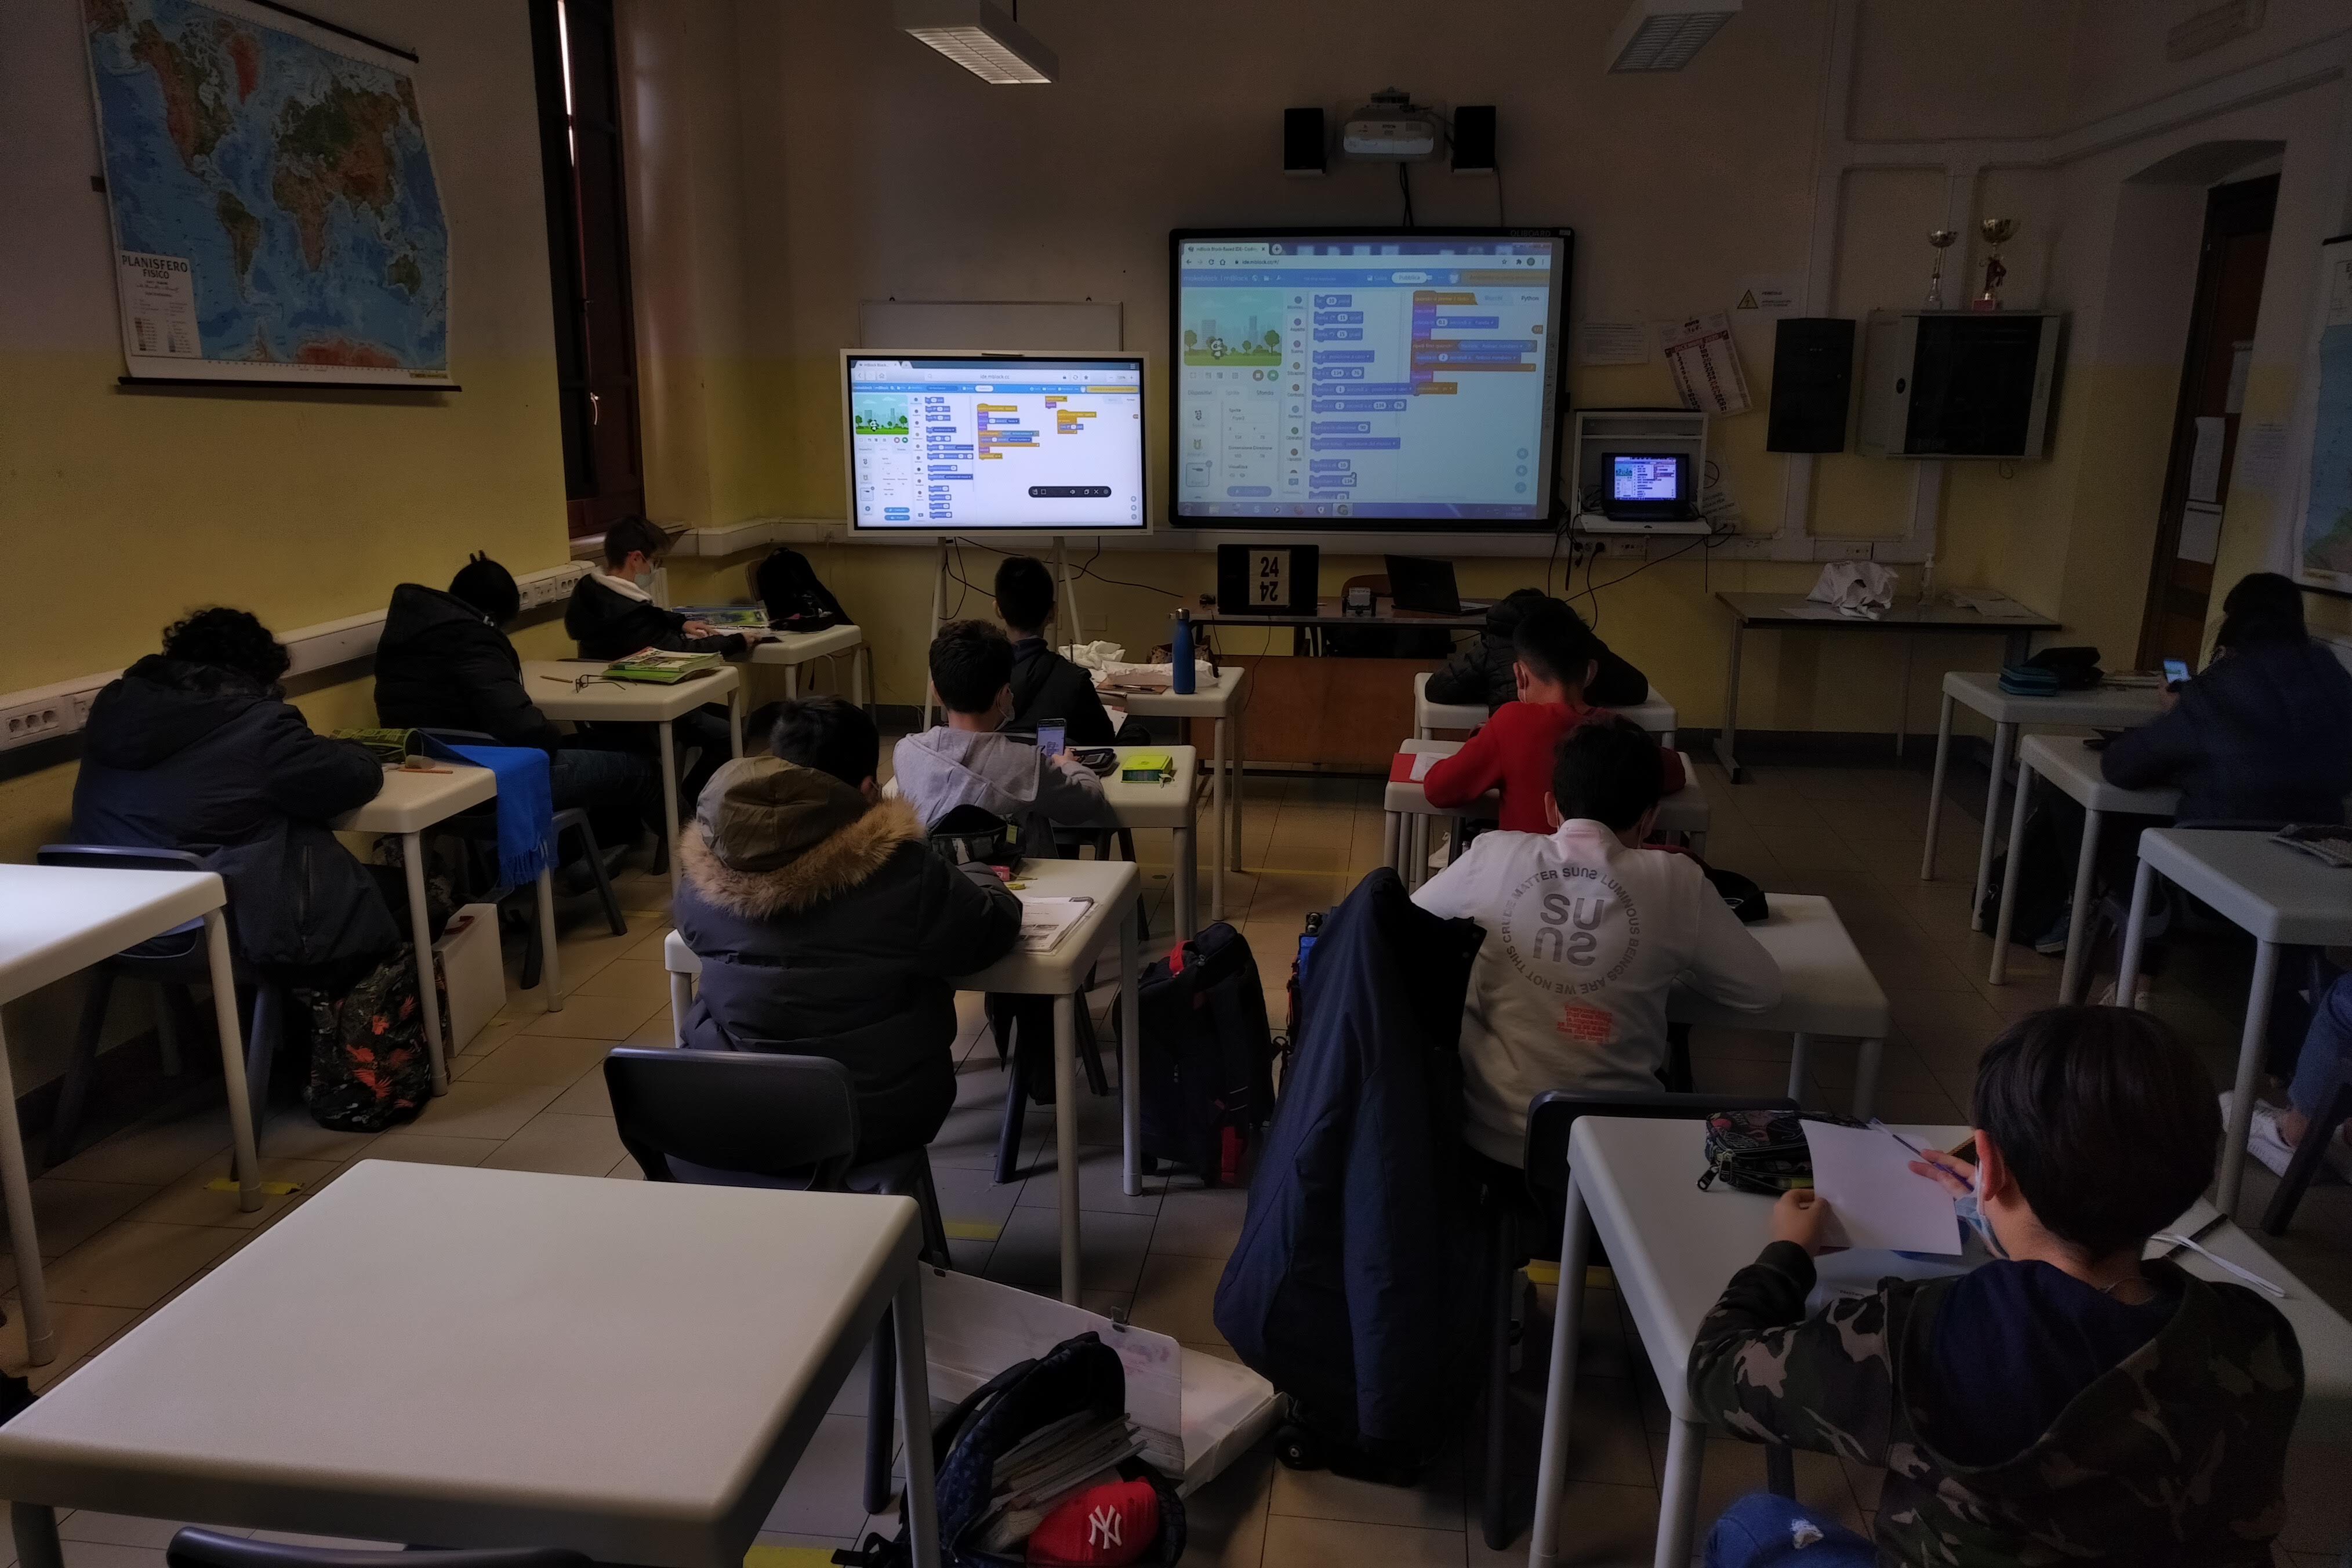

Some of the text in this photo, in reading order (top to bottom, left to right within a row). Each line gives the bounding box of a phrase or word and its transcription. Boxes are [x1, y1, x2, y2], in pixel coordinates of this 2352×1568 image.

[1510, 229, 1551, 237] OLIBOARD
[122, 255, 188, 273] PLANISFERO
[143, 269, 169, 280] FISICO
[1261, 557, 1279, 577] 24
[1511, 870, 1558, 900] MATTER
[1600, 874, 1640, 935] LUMINOUS
[1501, 900, 1516, 943] CRUDE
[1507, 946, 1526, 973] THIS
[1606, 938, 1639, 982] BEINGS
[1525, 971, 1552, 990] NOT
[1555, 983, 1577, 995] WE
[1580, 977, 1606, 994] ARE
[1088, 1504, 1123, 1549] NY
